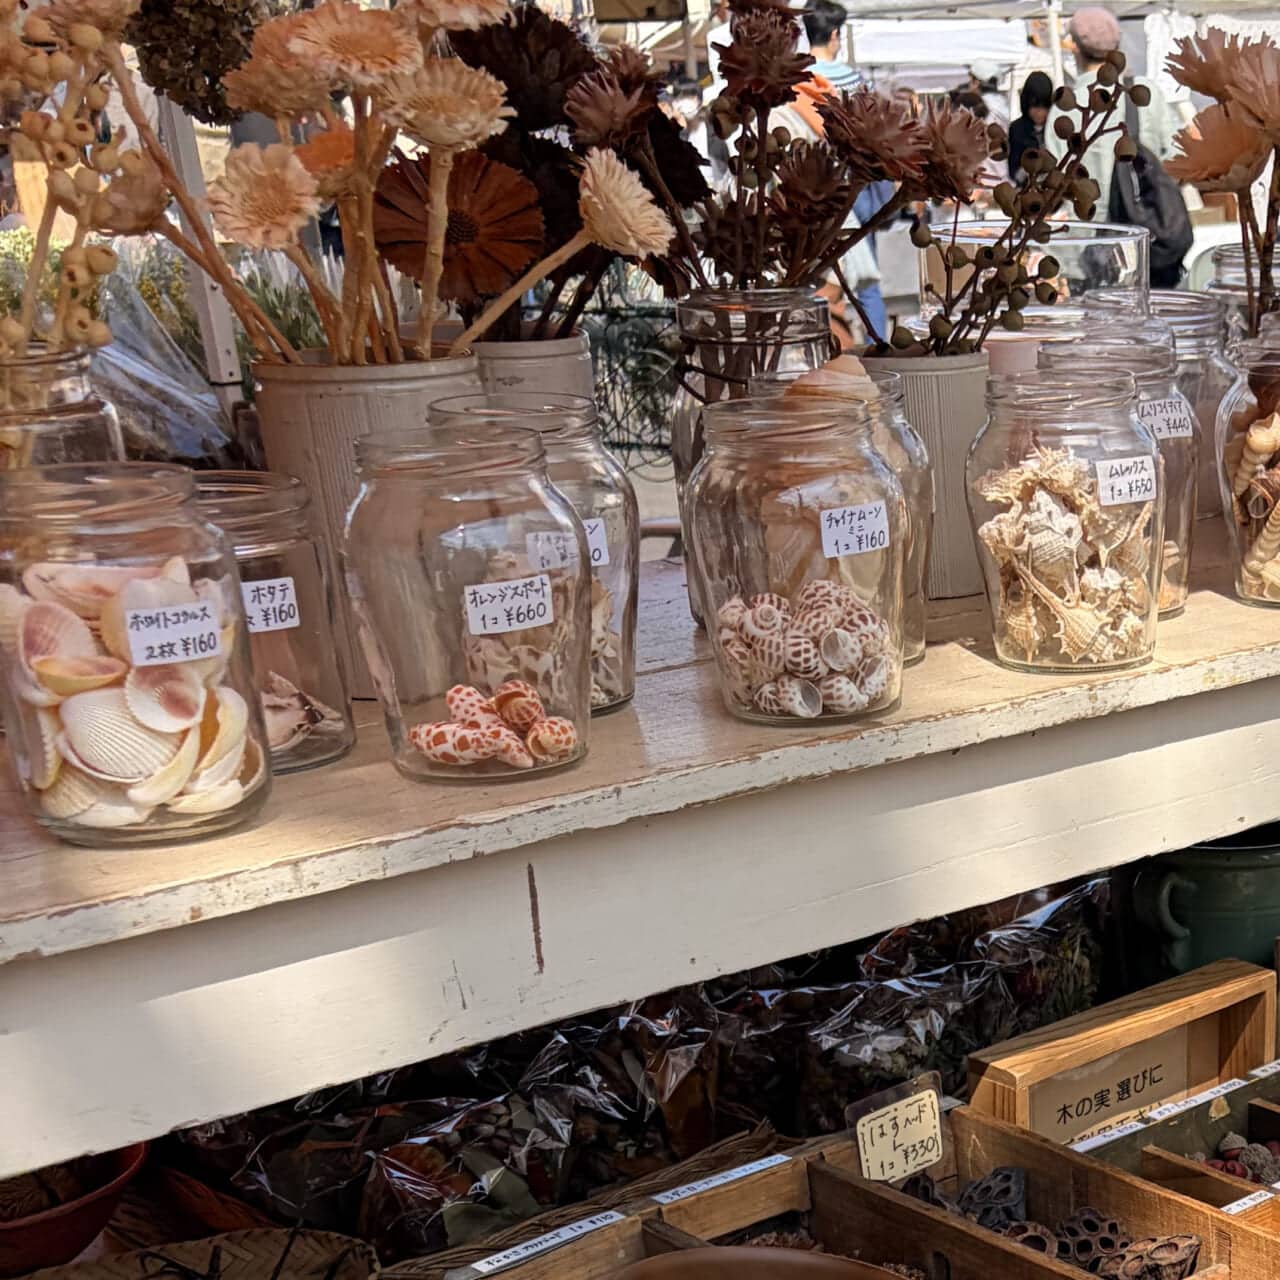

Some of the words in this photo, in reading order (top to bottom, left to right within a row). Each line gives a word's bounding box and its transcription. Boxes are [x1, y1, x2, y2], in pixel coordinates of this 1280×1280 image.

[1163, 417, 1190, 435] ¥440
[1128, 478, 1152, 498] ¥550
[856, 530, 886, 551] ¥160
[250, 585, 290, 605] ホタテ
[468, 577, 548, 608] オレンジスポット
[261, 602, 297, 627] ¥160
[504, 602, 547, 627] ¥660
[180, 631, 217, 657] ¥160
[902, 1136, 936, 1166] ¥330
